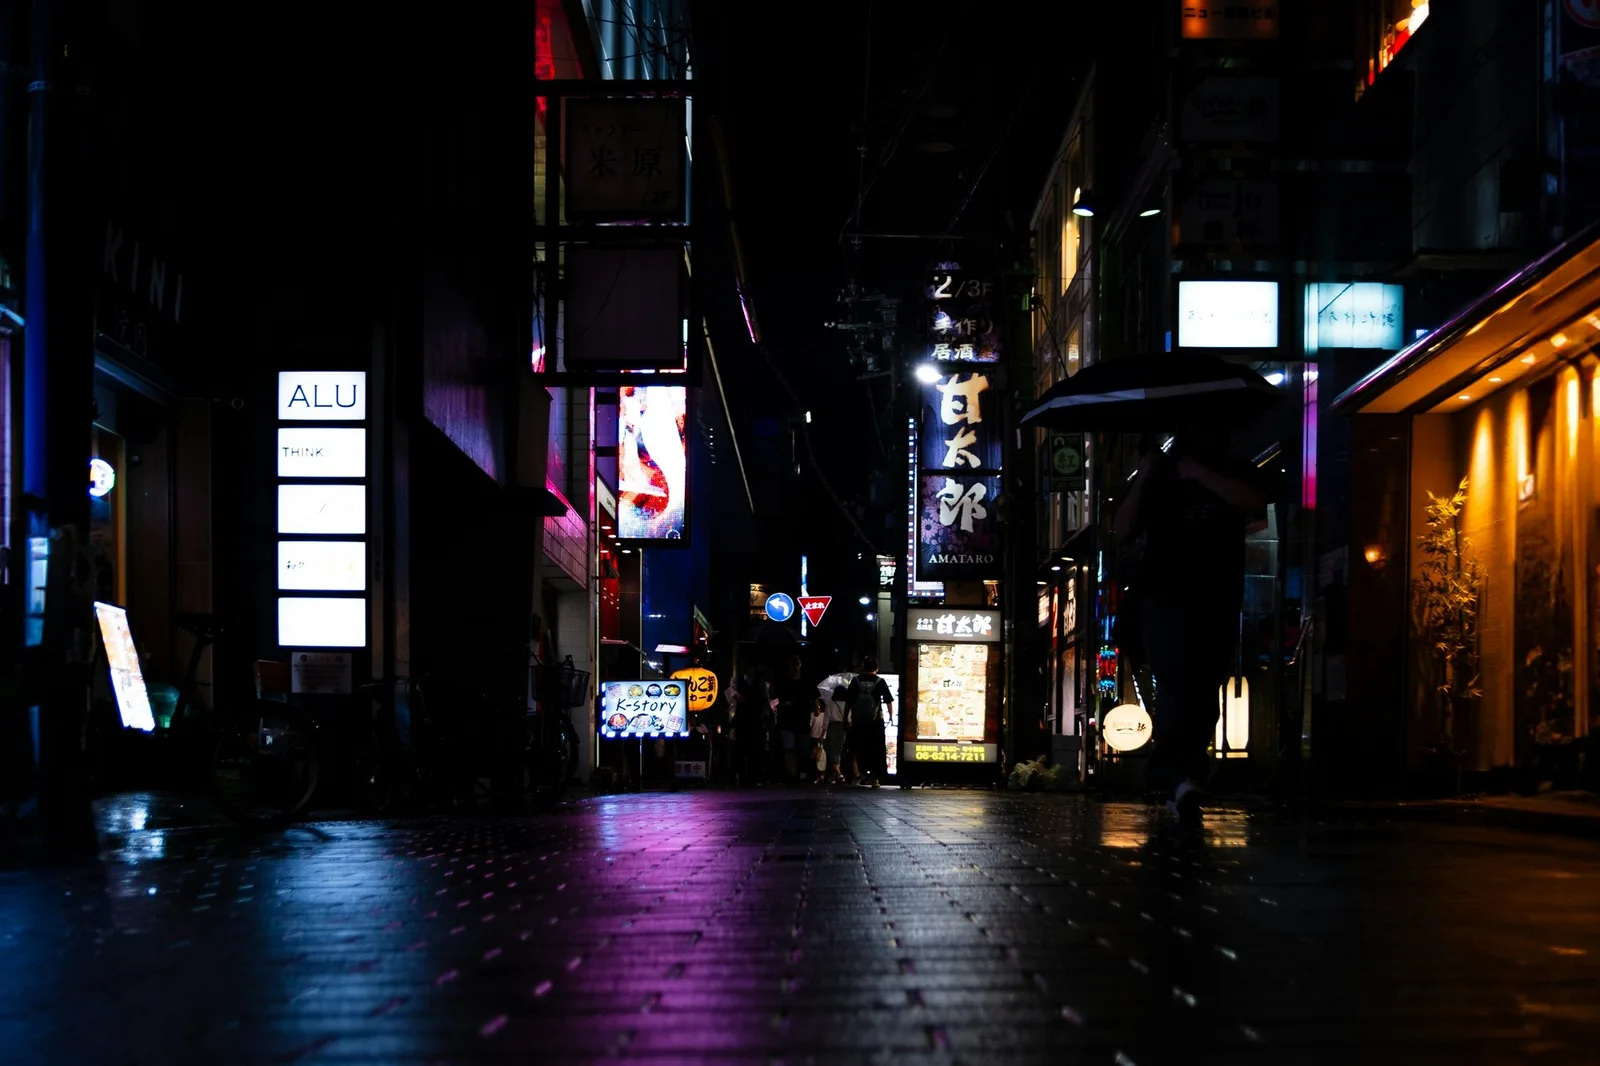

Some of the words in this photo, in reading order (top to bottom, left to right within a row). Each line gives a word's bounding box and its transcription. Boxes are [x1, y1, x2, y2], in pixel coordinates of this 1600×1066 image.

[287, 384, 357, 408] ALU
[282, 447, 324, 457] THINK
[936, 372, 990, 532] 甘太郎
[929, 553, 993, 564] AMATARO
[935, 614, 991, 635] 甘太郎
[616, 699, 676, 714] K-story
[916, 752, 984, 761] 06-6214-7211
